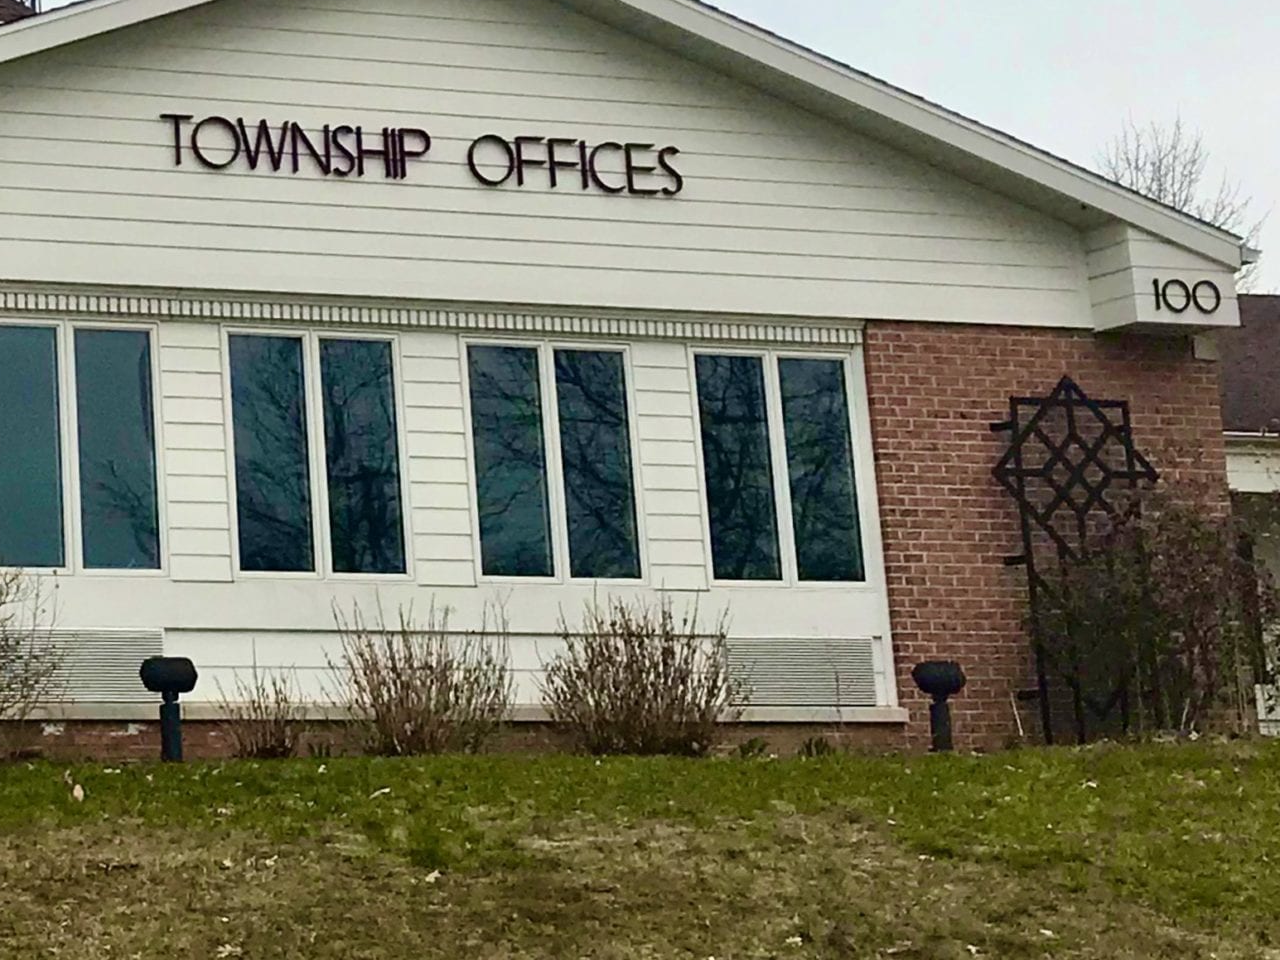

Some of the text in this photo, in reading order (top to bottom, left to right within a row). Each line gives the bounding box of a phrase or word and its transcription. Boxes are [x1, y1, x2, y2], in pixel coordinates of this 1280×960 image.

[159, 114, 683, 196] TOWNSHIP OFFICES
[1152, 278, 1221, 314] 100
